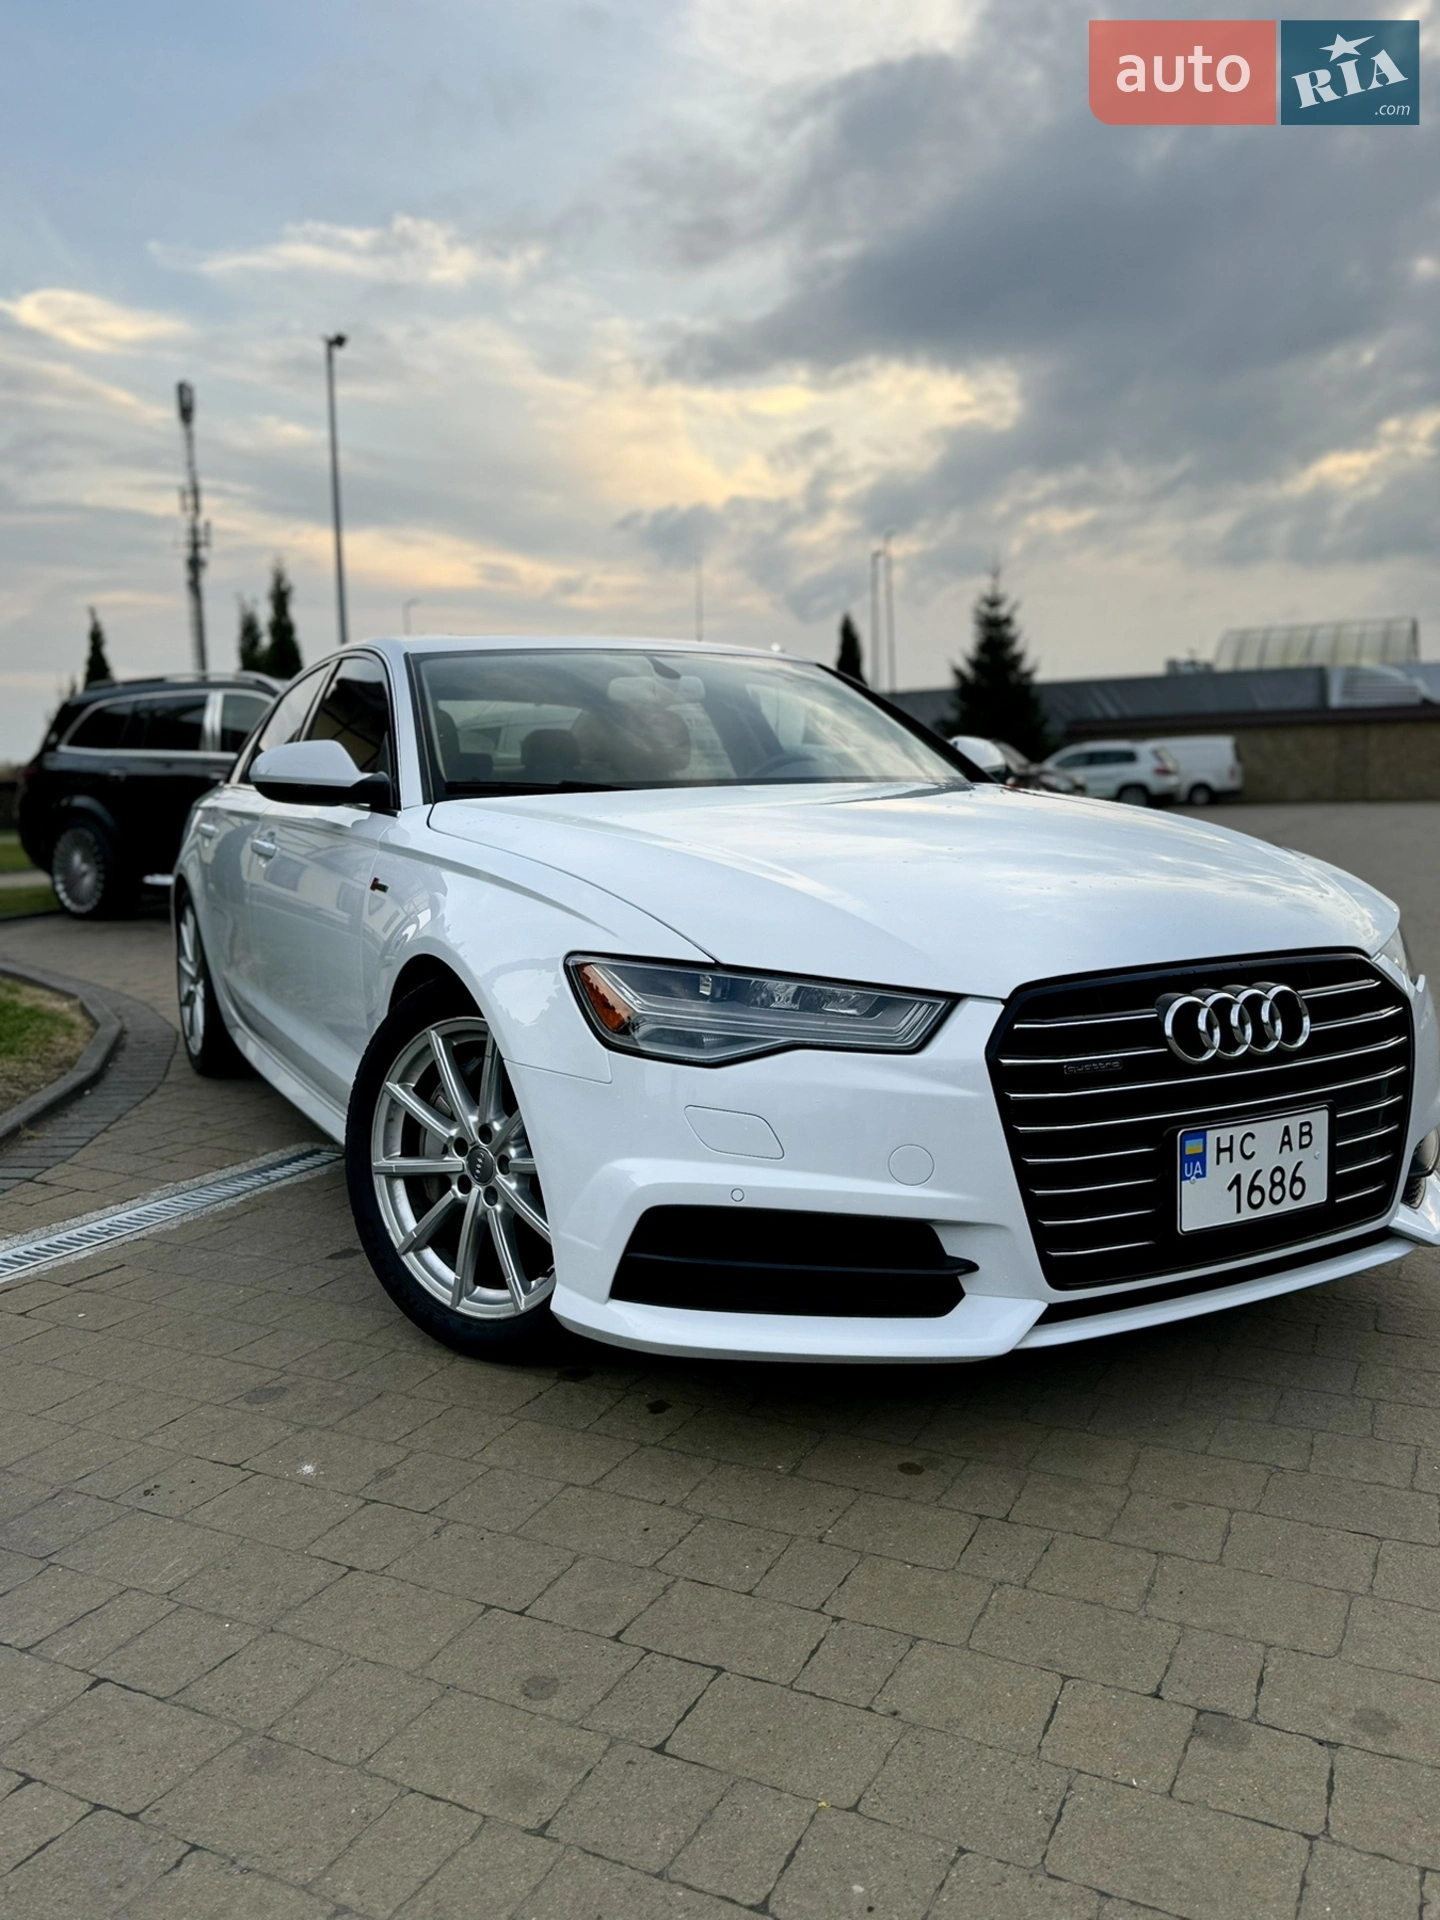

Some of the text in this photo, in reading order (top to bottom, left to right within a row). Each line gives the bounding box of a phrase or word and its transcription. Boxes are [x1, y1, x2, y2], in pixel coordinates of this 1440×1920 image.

[1216, 1120, 1313, 1166] HC AB
[1184, 1161, 1203, 1177] UA
[1227, 1160, 1306, 1214] 1686
